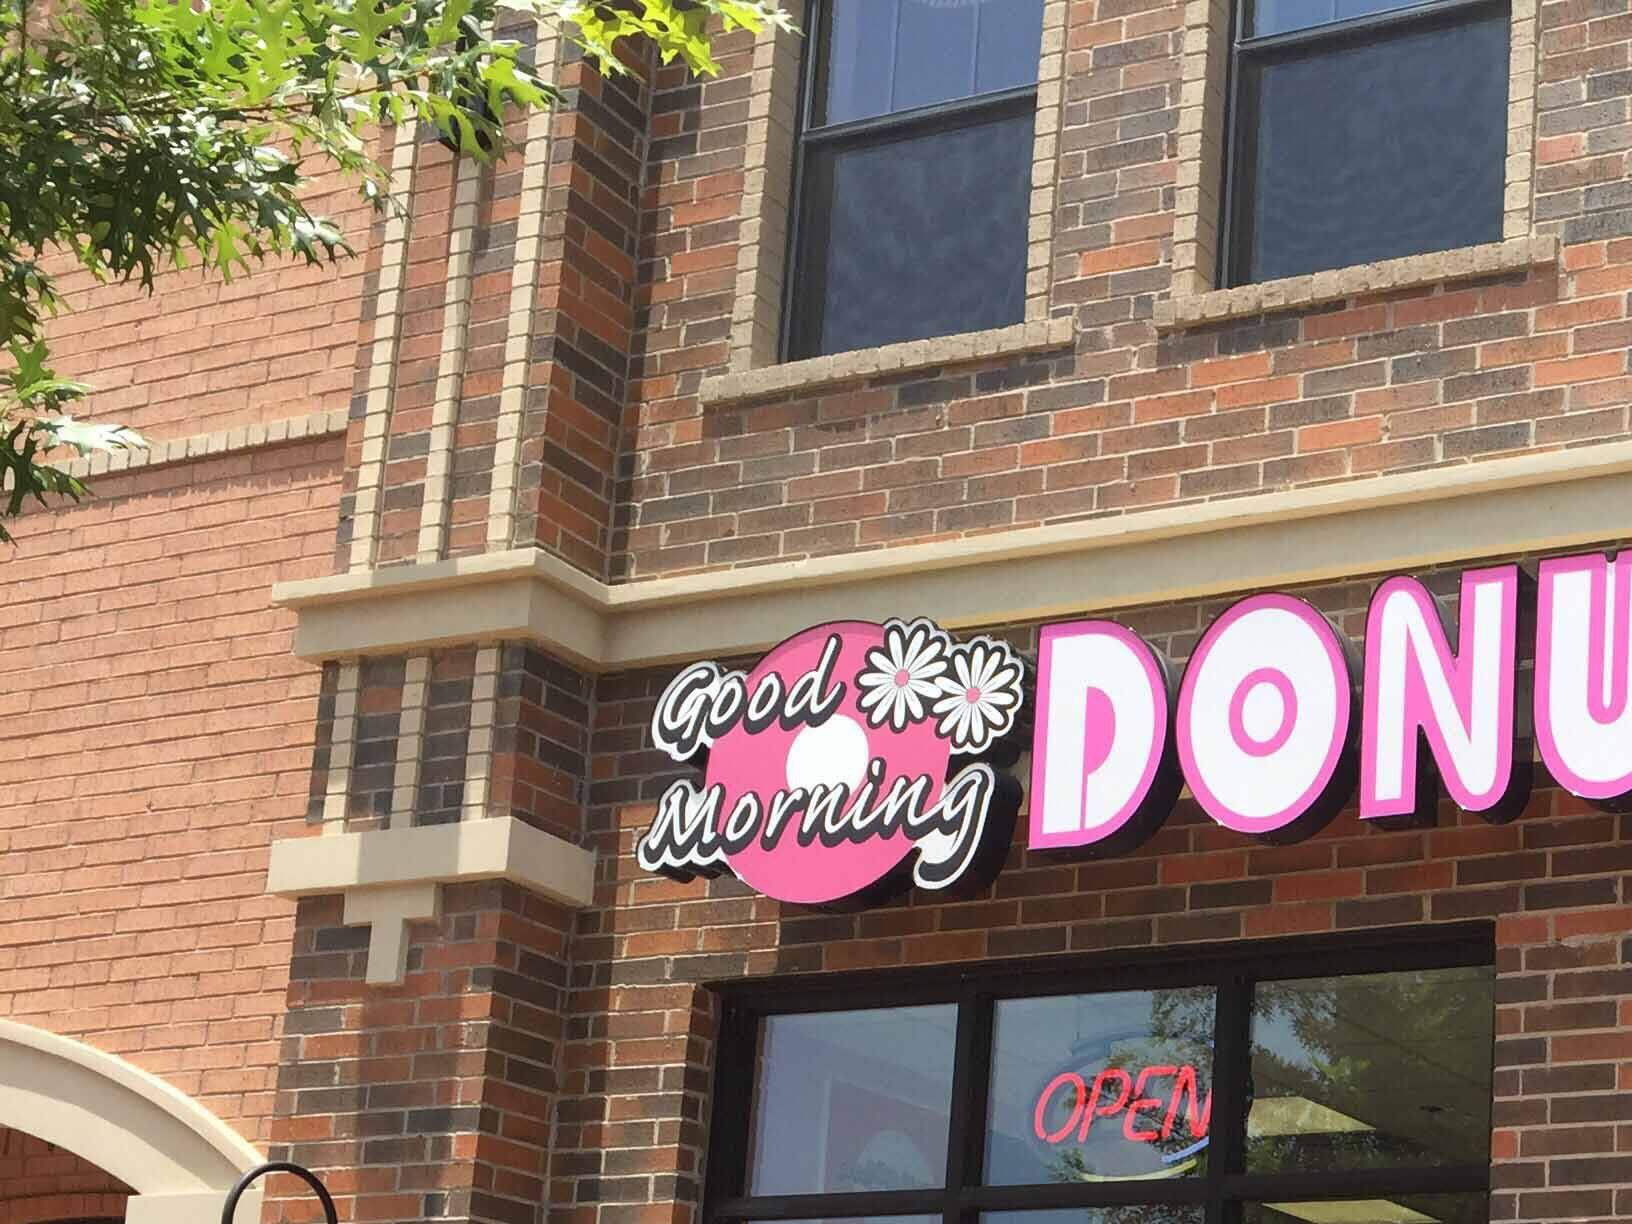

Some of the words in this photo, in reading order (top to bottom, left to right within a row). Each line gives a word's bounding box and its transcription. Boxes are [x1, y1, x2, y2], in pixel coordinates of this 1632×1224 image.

[652, 632, 848, 760] Good
[637, 756, 995, 890] Morning
[1033, 1063, 1213, 1143] OPEN
